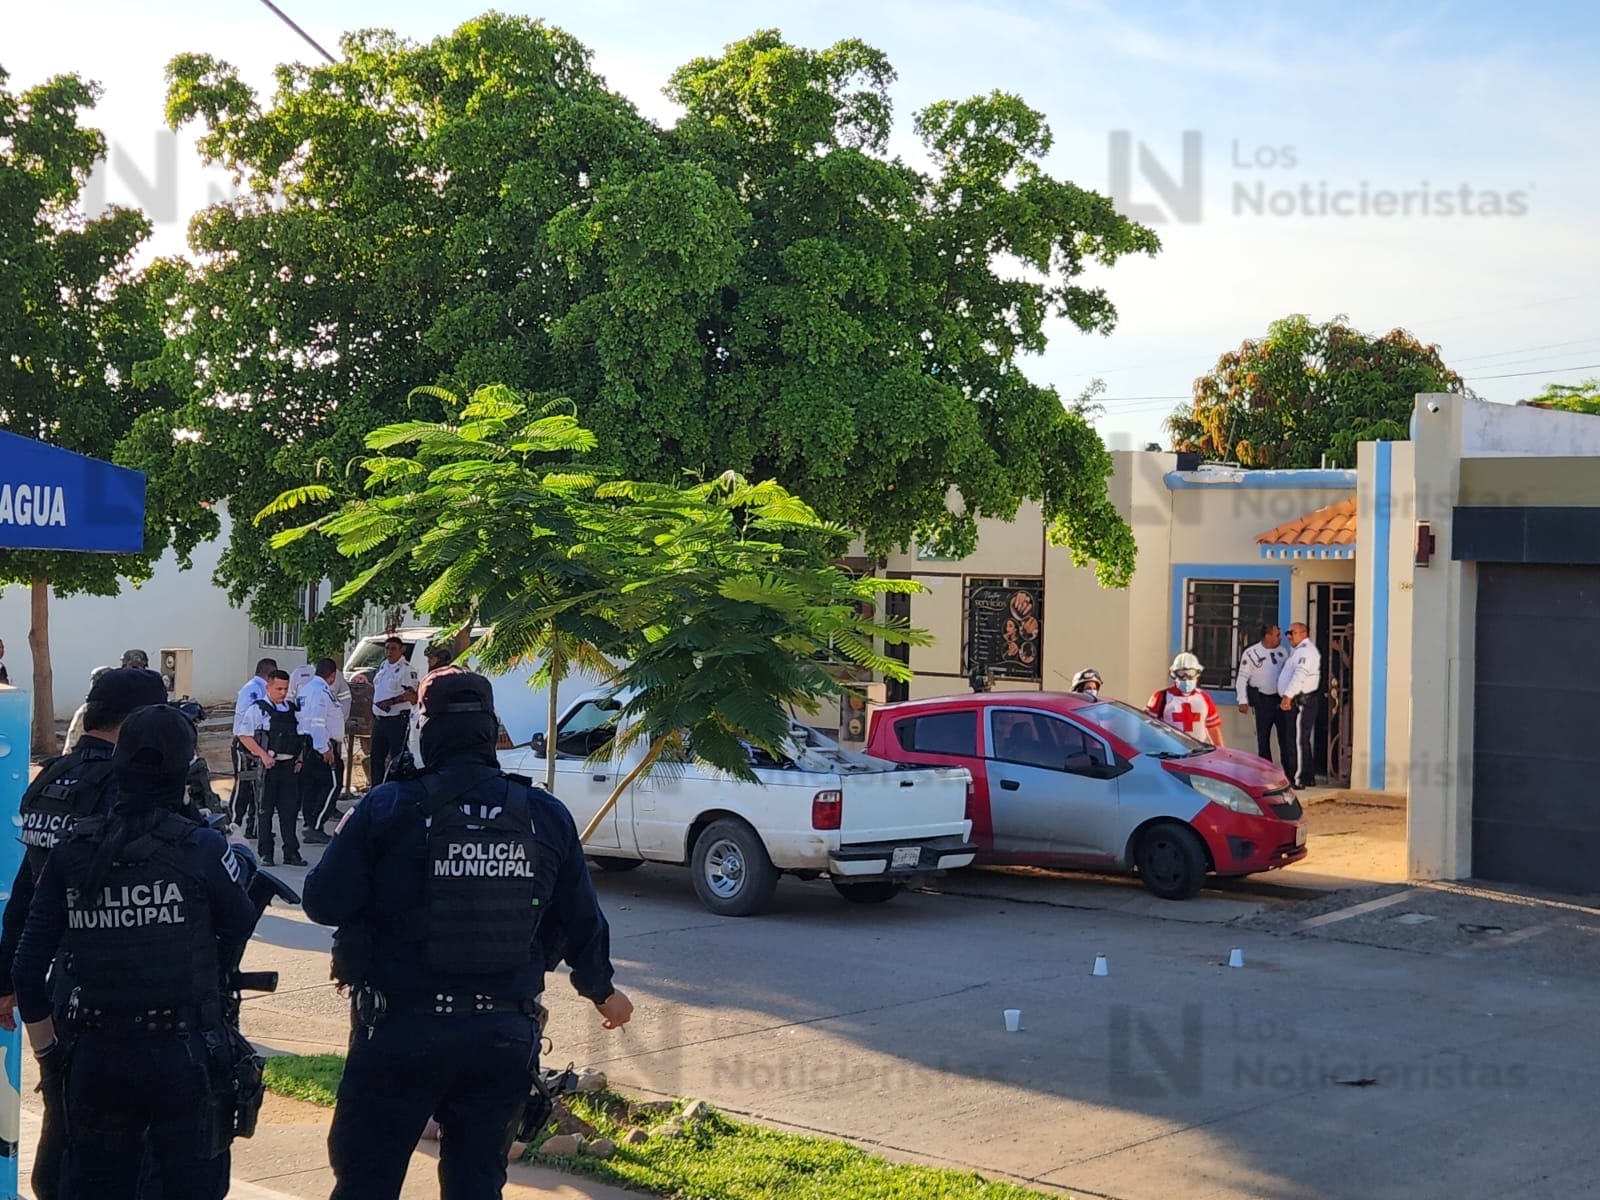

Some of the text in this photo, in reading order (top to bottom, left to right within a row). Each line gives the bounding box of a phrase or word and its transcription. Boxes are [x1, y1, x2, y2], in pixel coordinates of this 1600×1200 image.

[0, 484, 66, 526] AGUA
[448, 841, 526, 860] POLICÍA
[434, 860, 535, 877] MUNICIPAL
[66, 880, 185, 908] PLICÍA
[68, 905, 185, 929] MUNICIPAL
